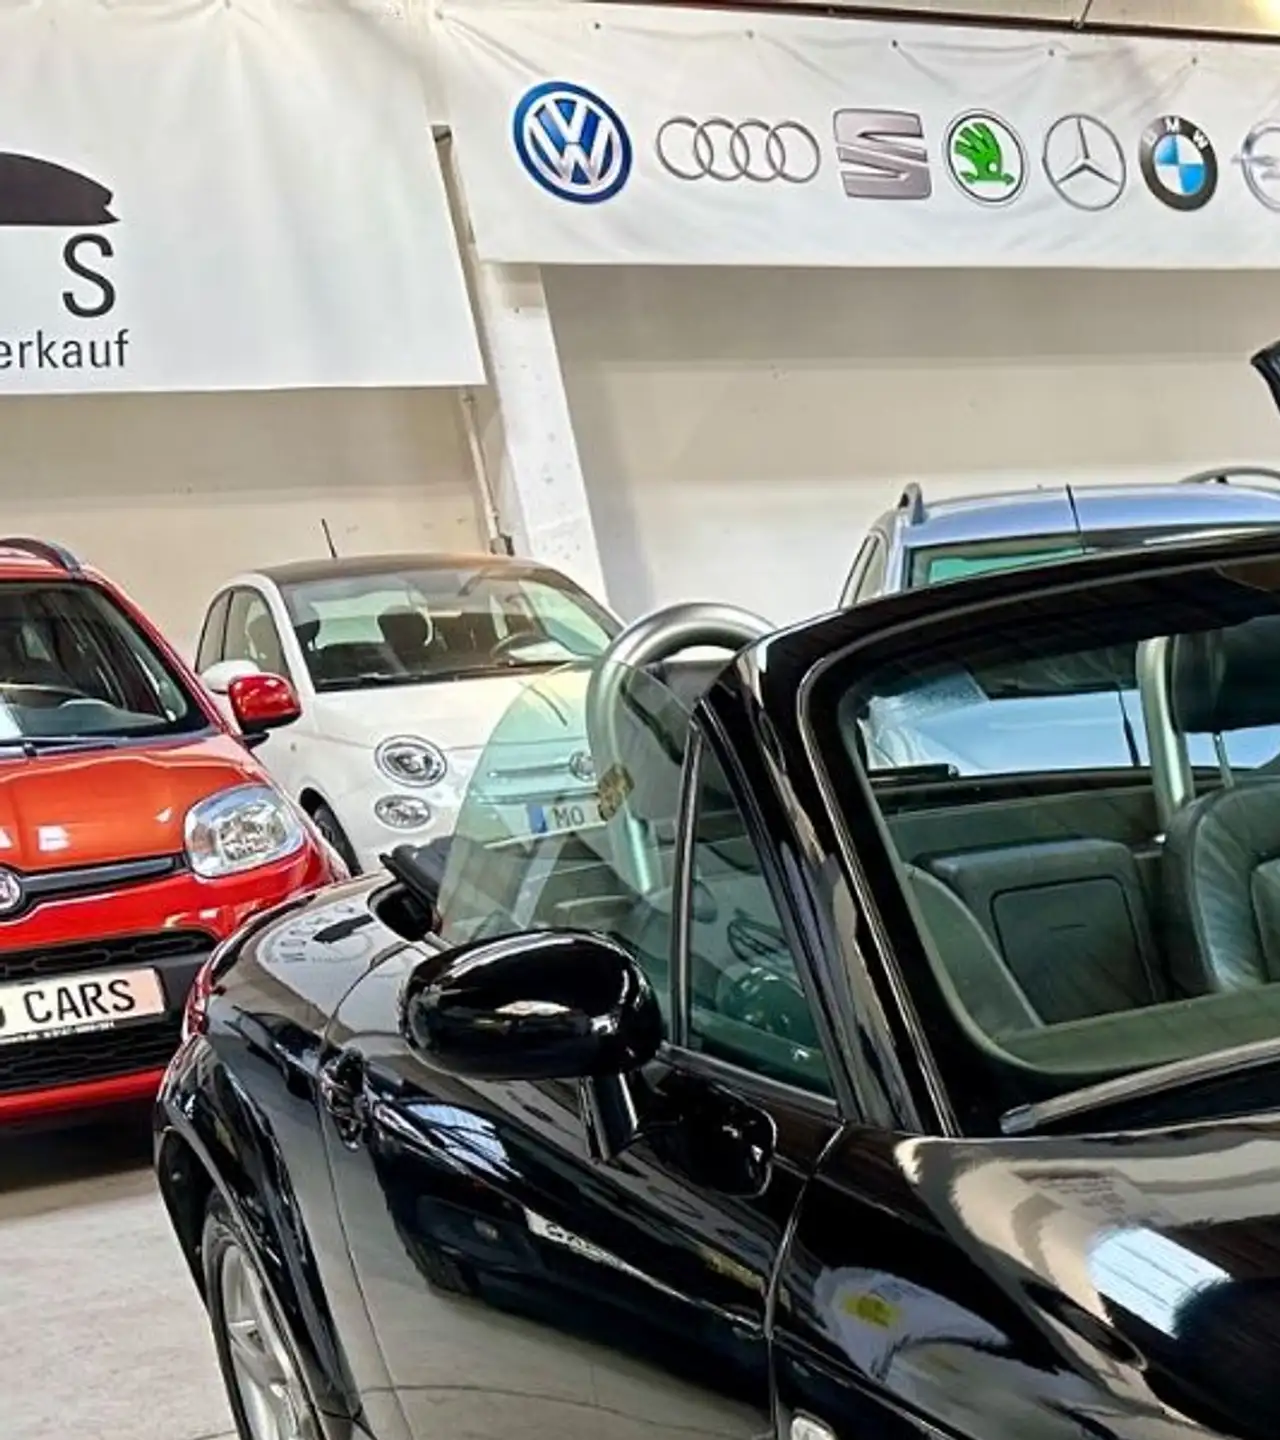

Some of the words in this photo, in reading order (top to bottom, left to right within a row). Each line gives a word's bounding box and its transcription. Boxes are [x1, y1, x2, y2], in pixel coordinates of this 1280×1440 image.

[62, 233, 116, 318] S
[0, 328, 129, 370] erkauf
[23, 979, 136, 1024] CARS
